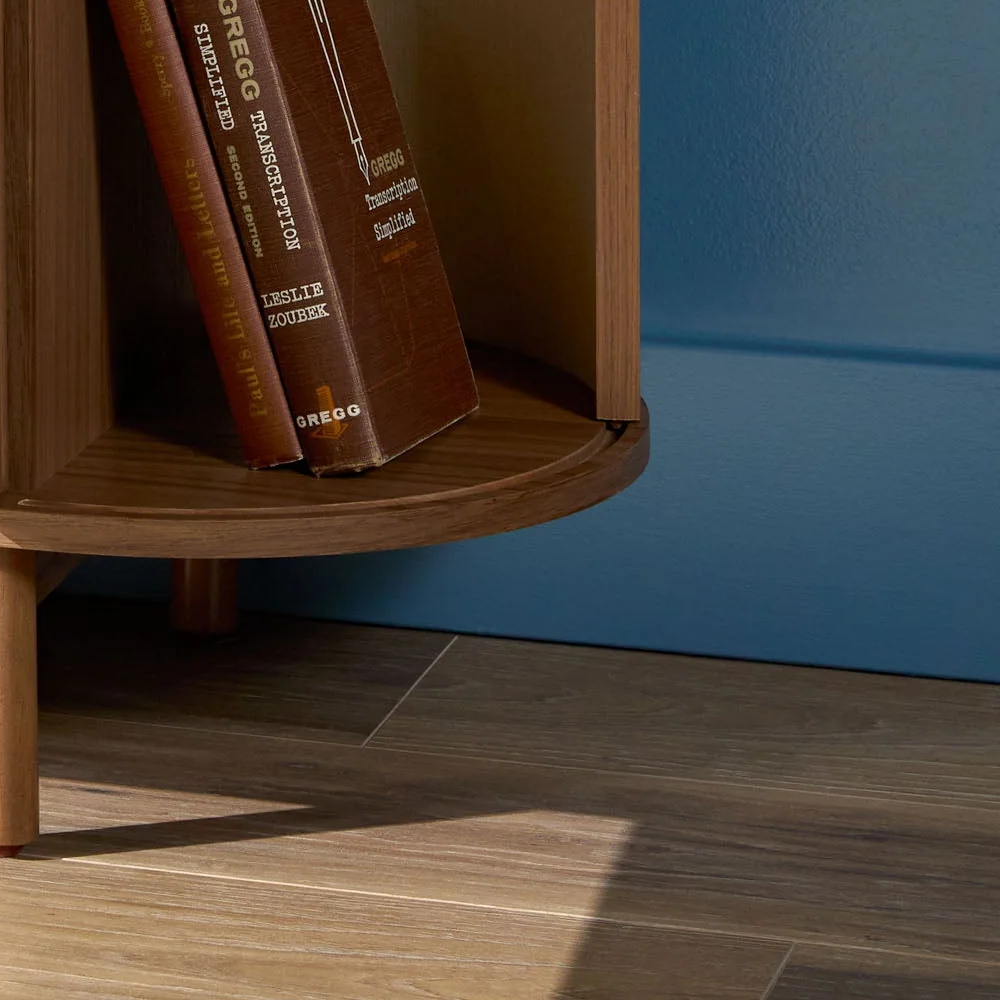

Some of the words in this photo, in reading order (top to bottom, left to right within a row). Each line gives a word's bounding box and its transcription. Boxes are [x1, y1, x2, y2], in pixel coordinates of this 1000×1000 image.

[193, 22, 235, 131] SIMPLIFIED
[226, 145, 248, 200] SECOND
[242, 204, 264, 258] EDITION
[370, 148, 405, 177] GREGG
[250, 110, 301, 251] TRANSCRIPTION
[364, 176, 419, 211] Transcription
[184, 158, 215, 240] Letters
[373, 207, 417, 242] Simplified
[203, 241, 229, 287] and
[261, 282, 324, 309] LESLIE
[267, 302, 330, 328] ZOUBEK
[296, 404, 361, 428] GREGG
